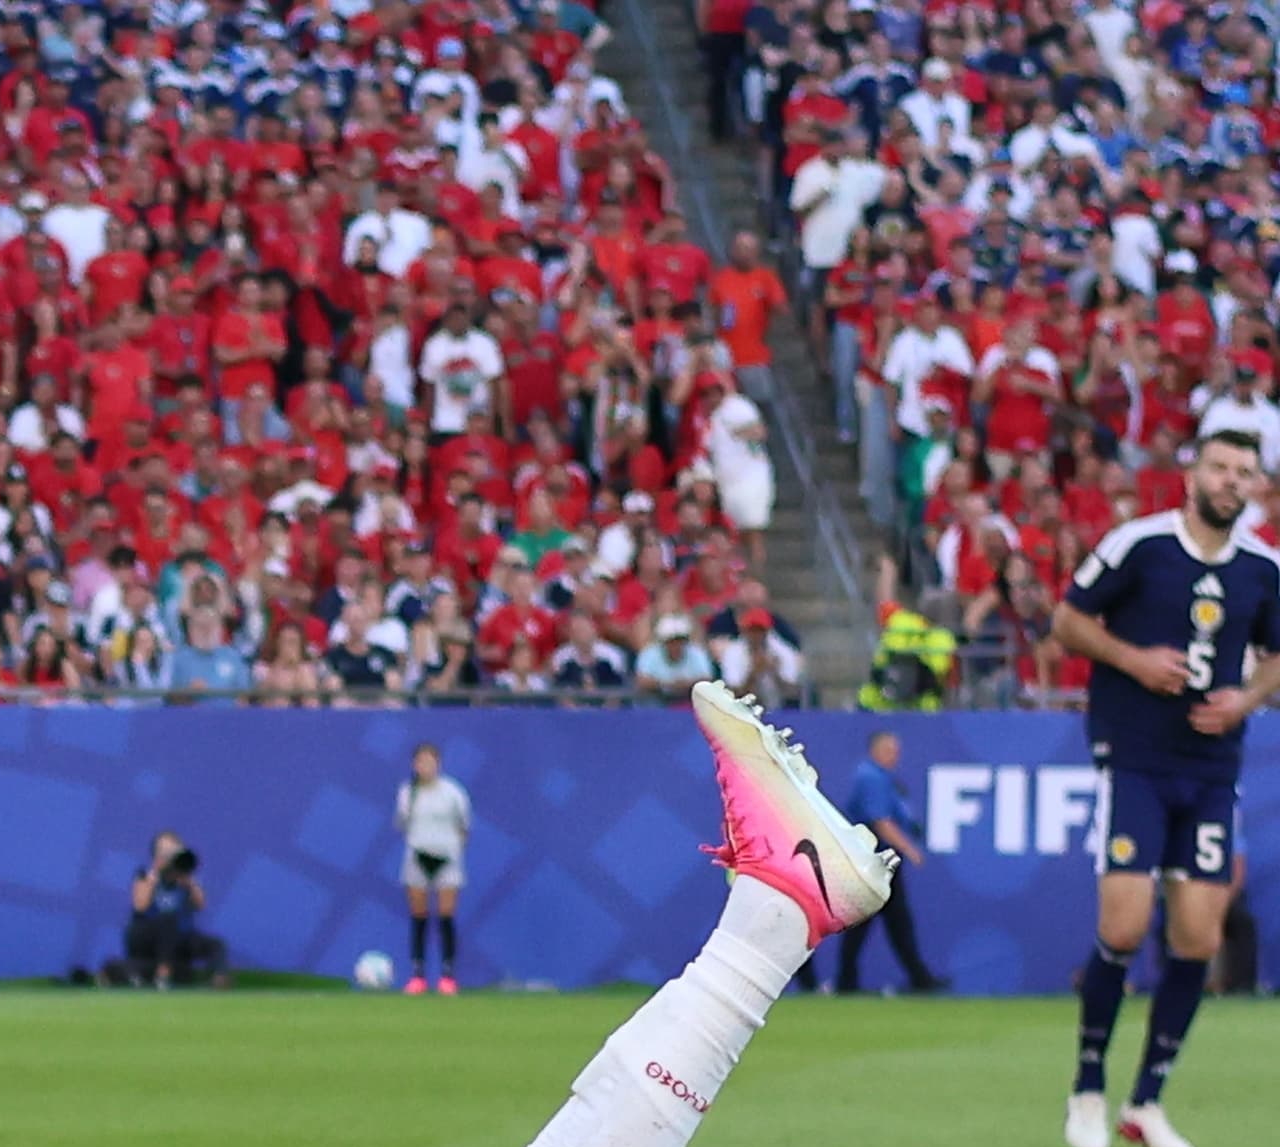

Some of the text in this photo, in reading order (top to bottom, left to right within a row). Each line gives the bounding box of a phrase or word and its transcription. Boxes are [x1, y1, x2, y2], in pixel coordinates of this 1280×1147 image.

[1186, 641, 1217, 691] 5
[927, 765, 1097, 854] FIF
[1195, 822, 1227, 873] 5
